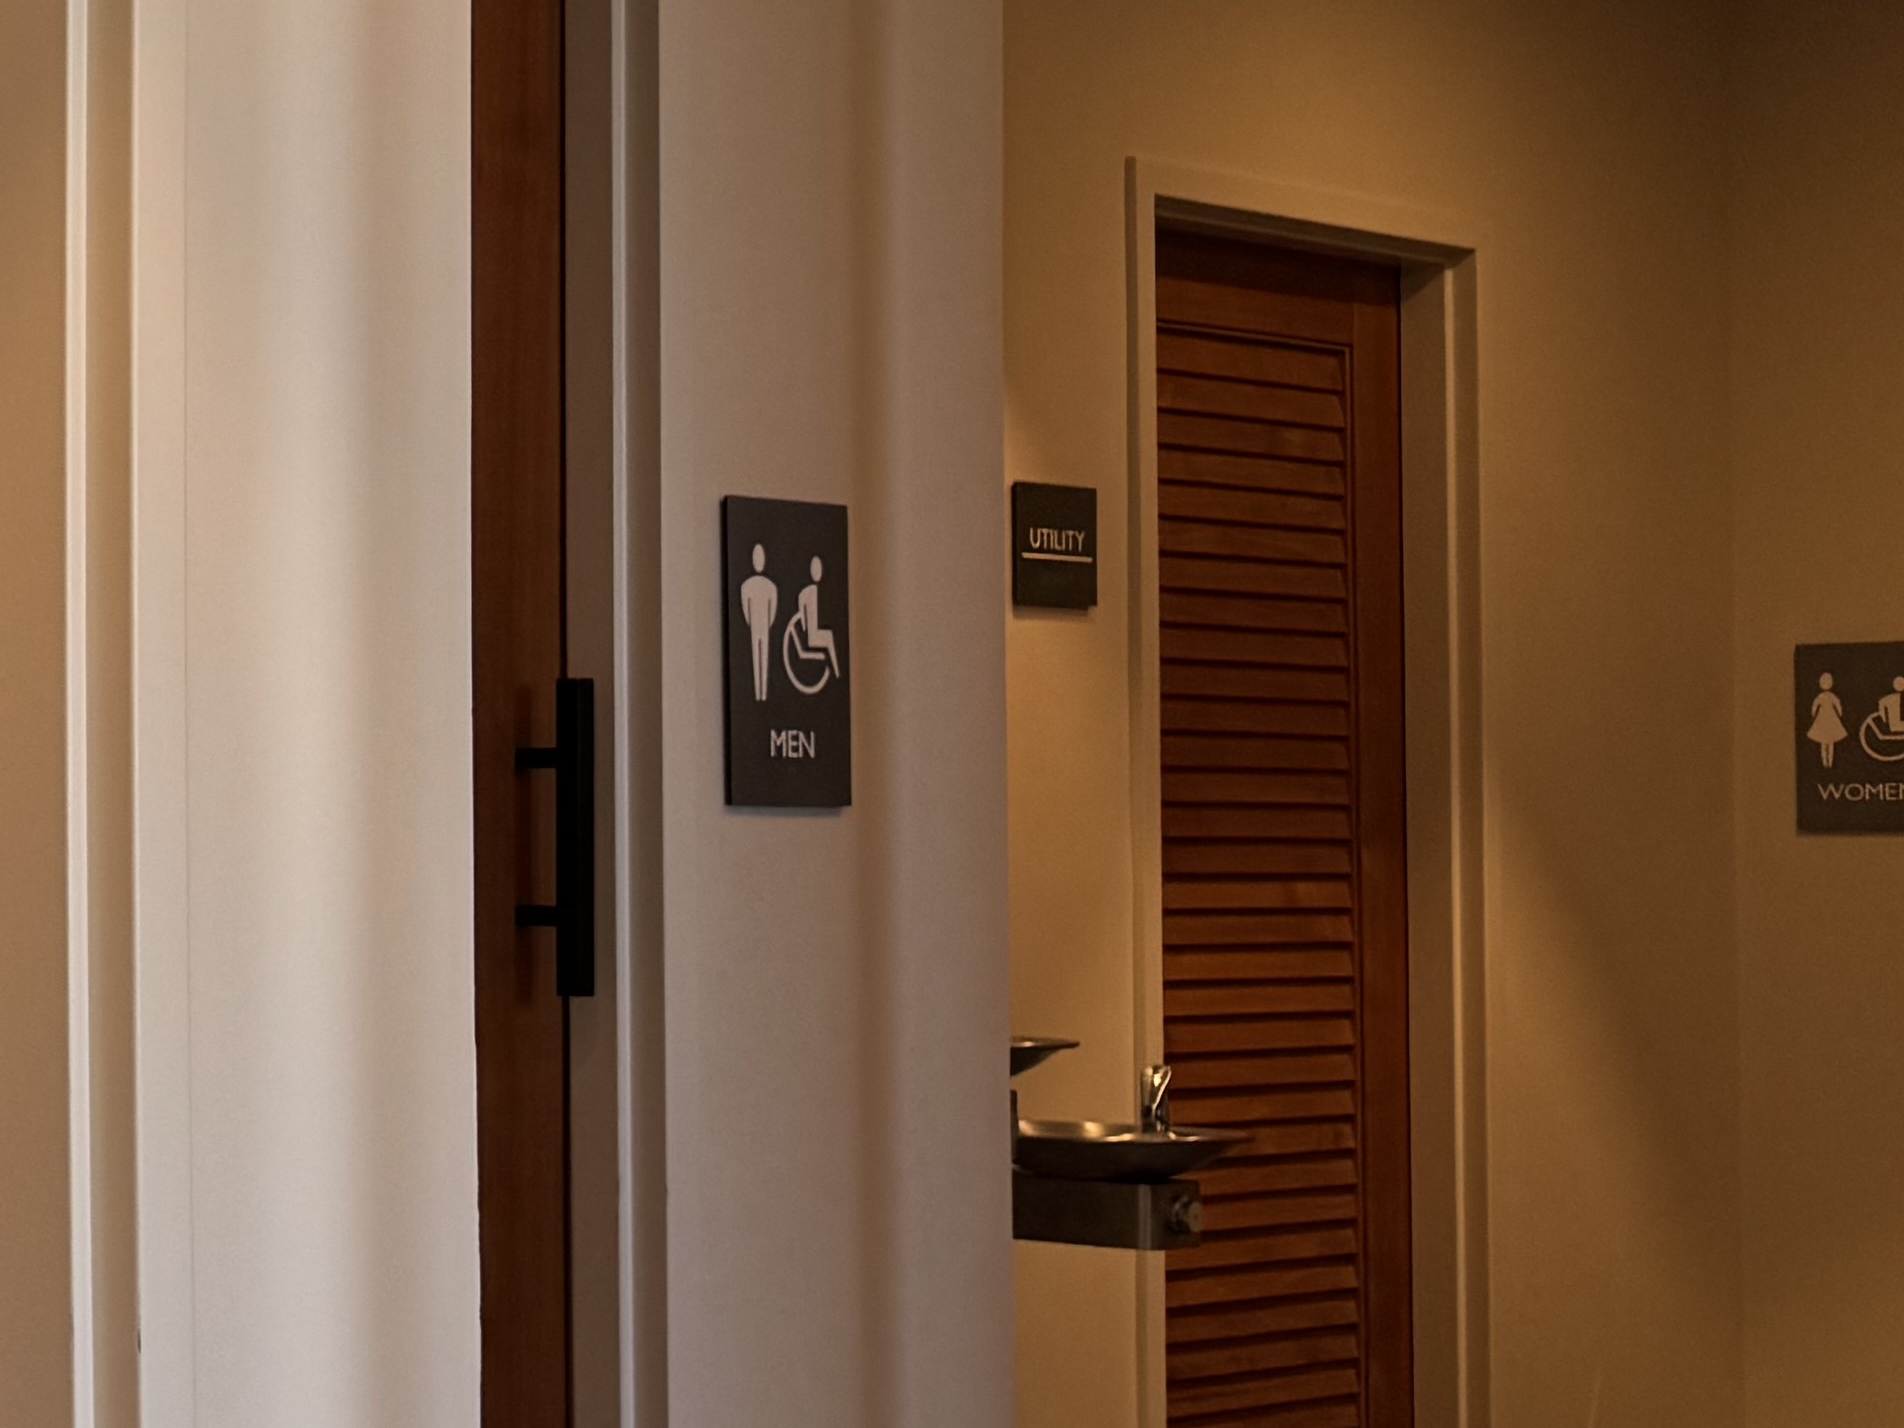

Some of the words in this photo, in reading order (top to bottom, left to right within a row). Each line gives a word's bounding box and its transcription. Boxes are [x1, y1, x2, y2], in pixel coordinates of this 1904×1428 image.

[1029, 527, 1085, 553] UTILITY
[769, 729, 816, 759] MEN
[1817, 782, 1904, 802] WOME
